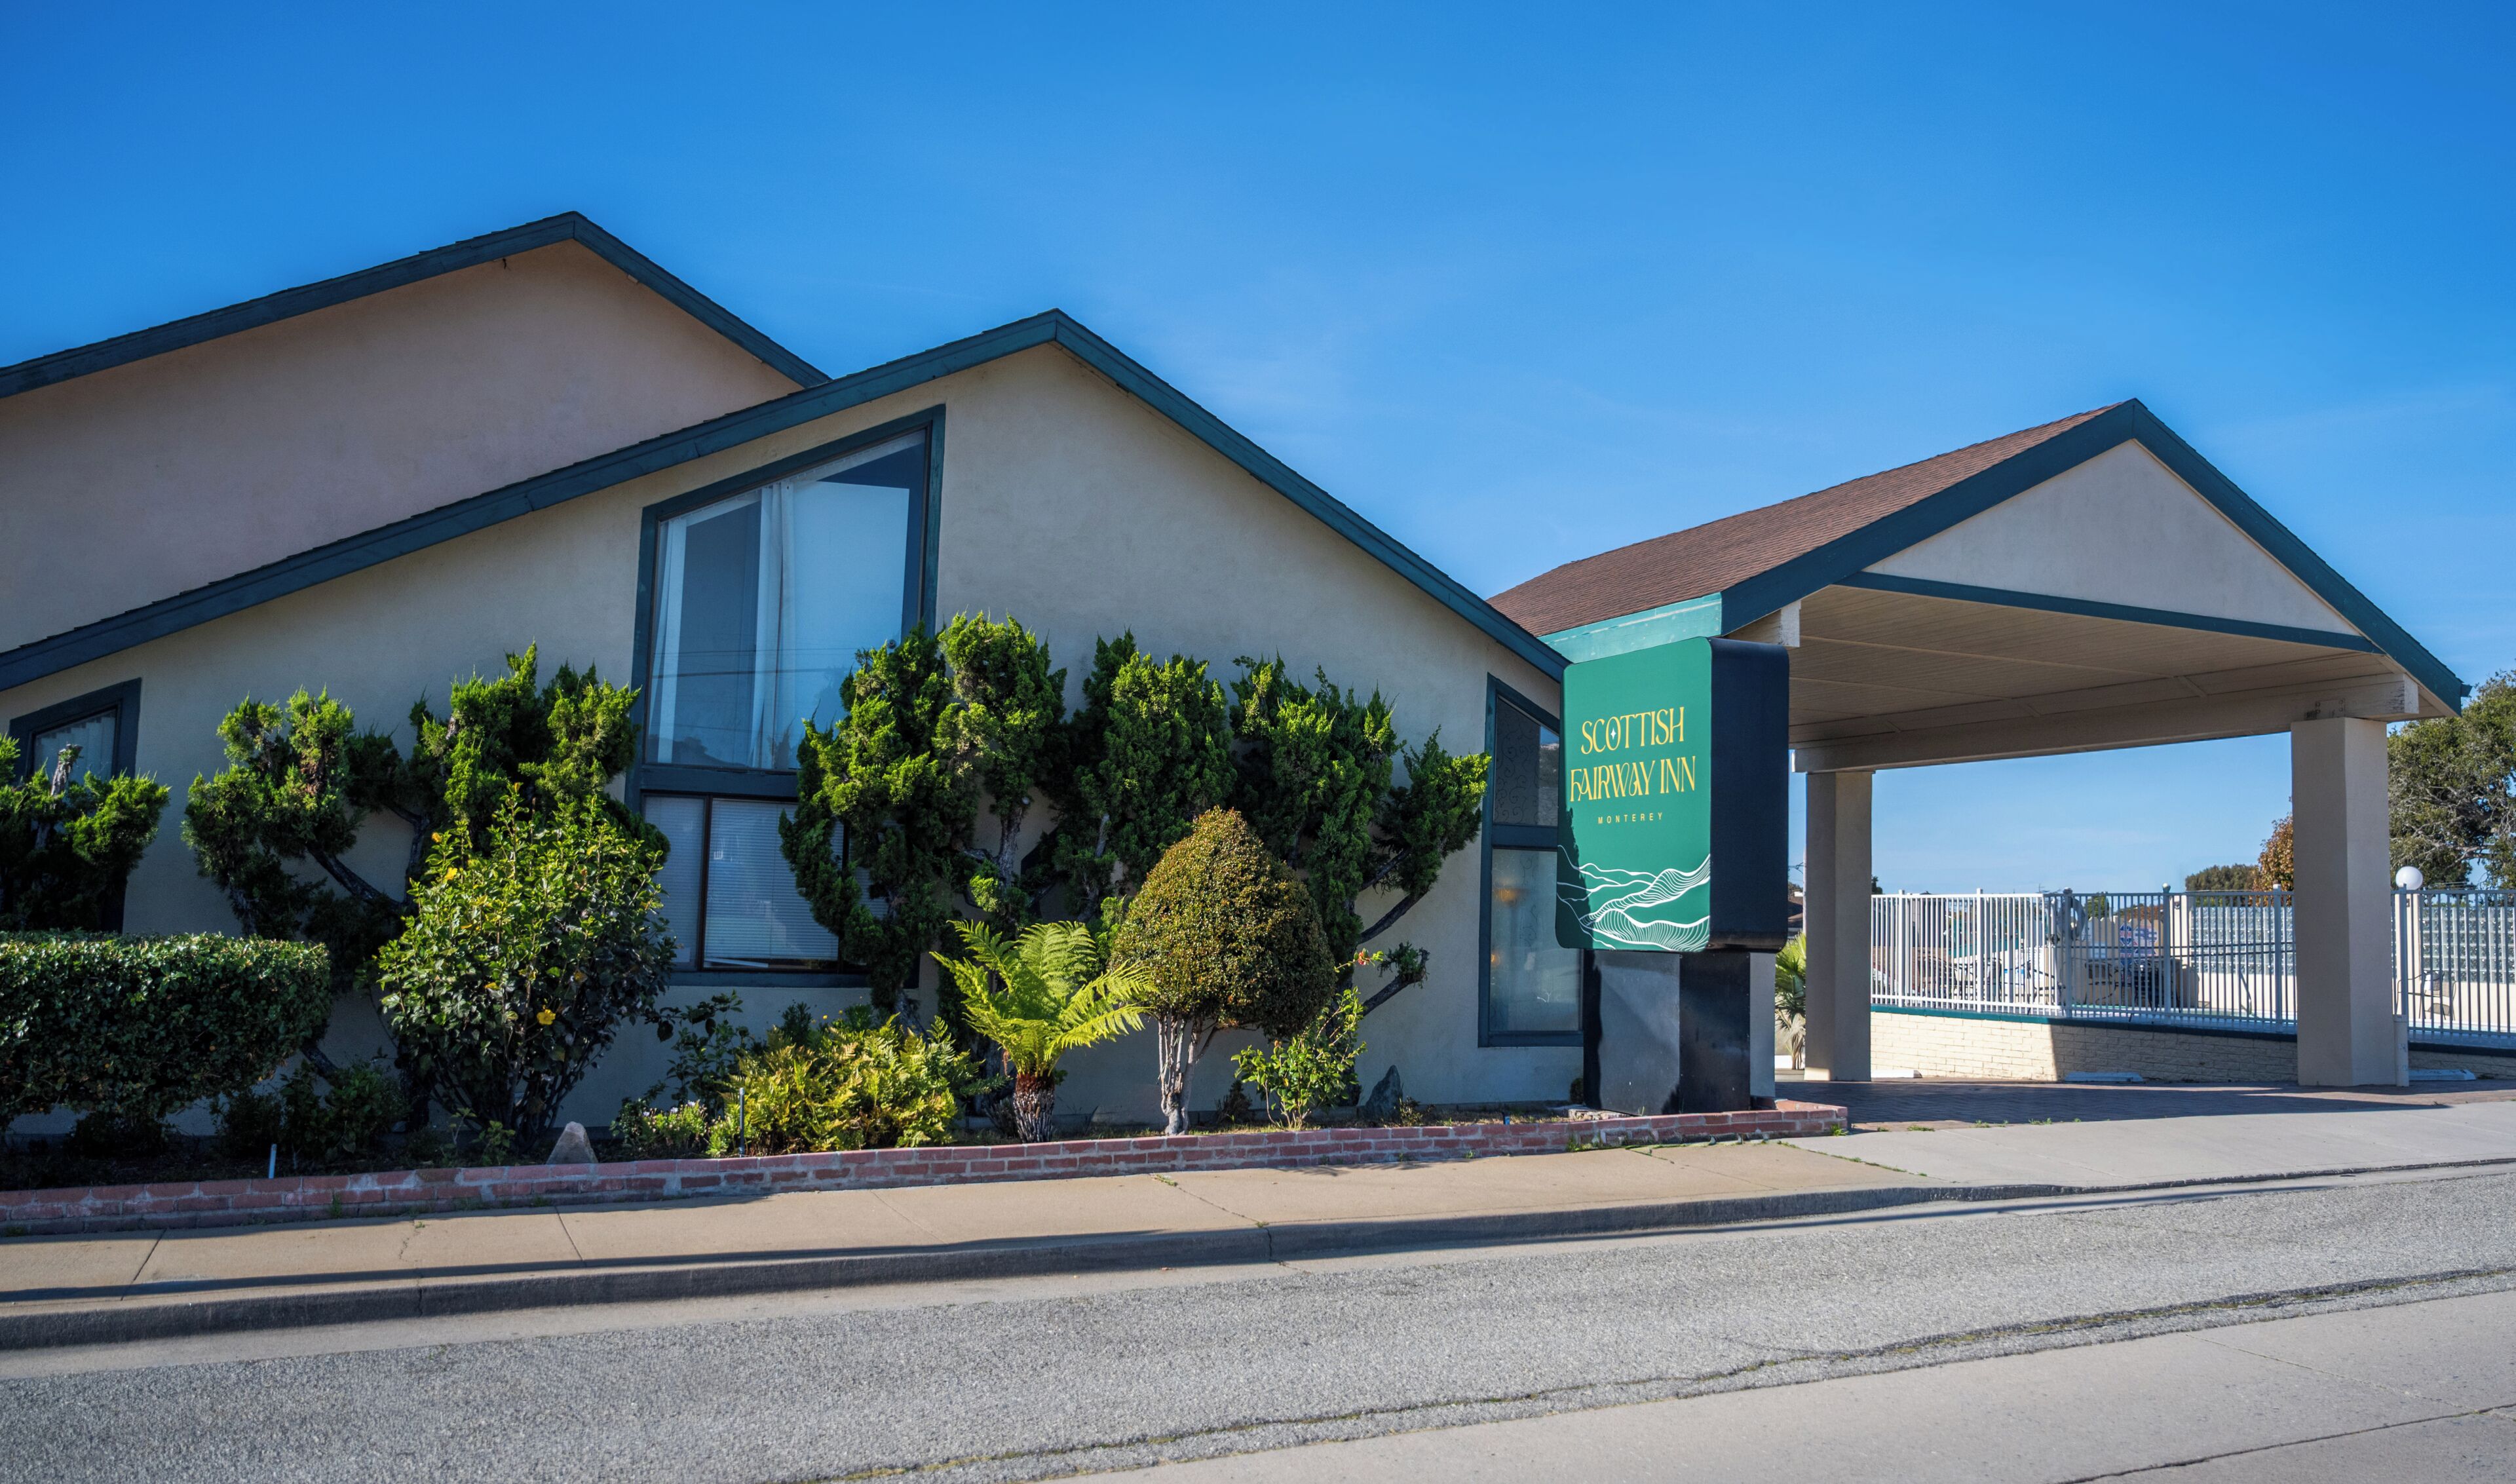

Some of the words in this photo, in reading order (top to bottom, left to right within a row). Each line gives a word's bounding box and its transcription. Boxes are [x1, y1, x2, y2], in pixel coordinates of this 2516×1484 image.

[1580, 706, 1685, 755] SCOTTISH
[1569, 760, 1656, 803] FAIRWAY
[1660, 755, 1696, 794] INN
[1597, 812, 1664, 824] MONTEREY
